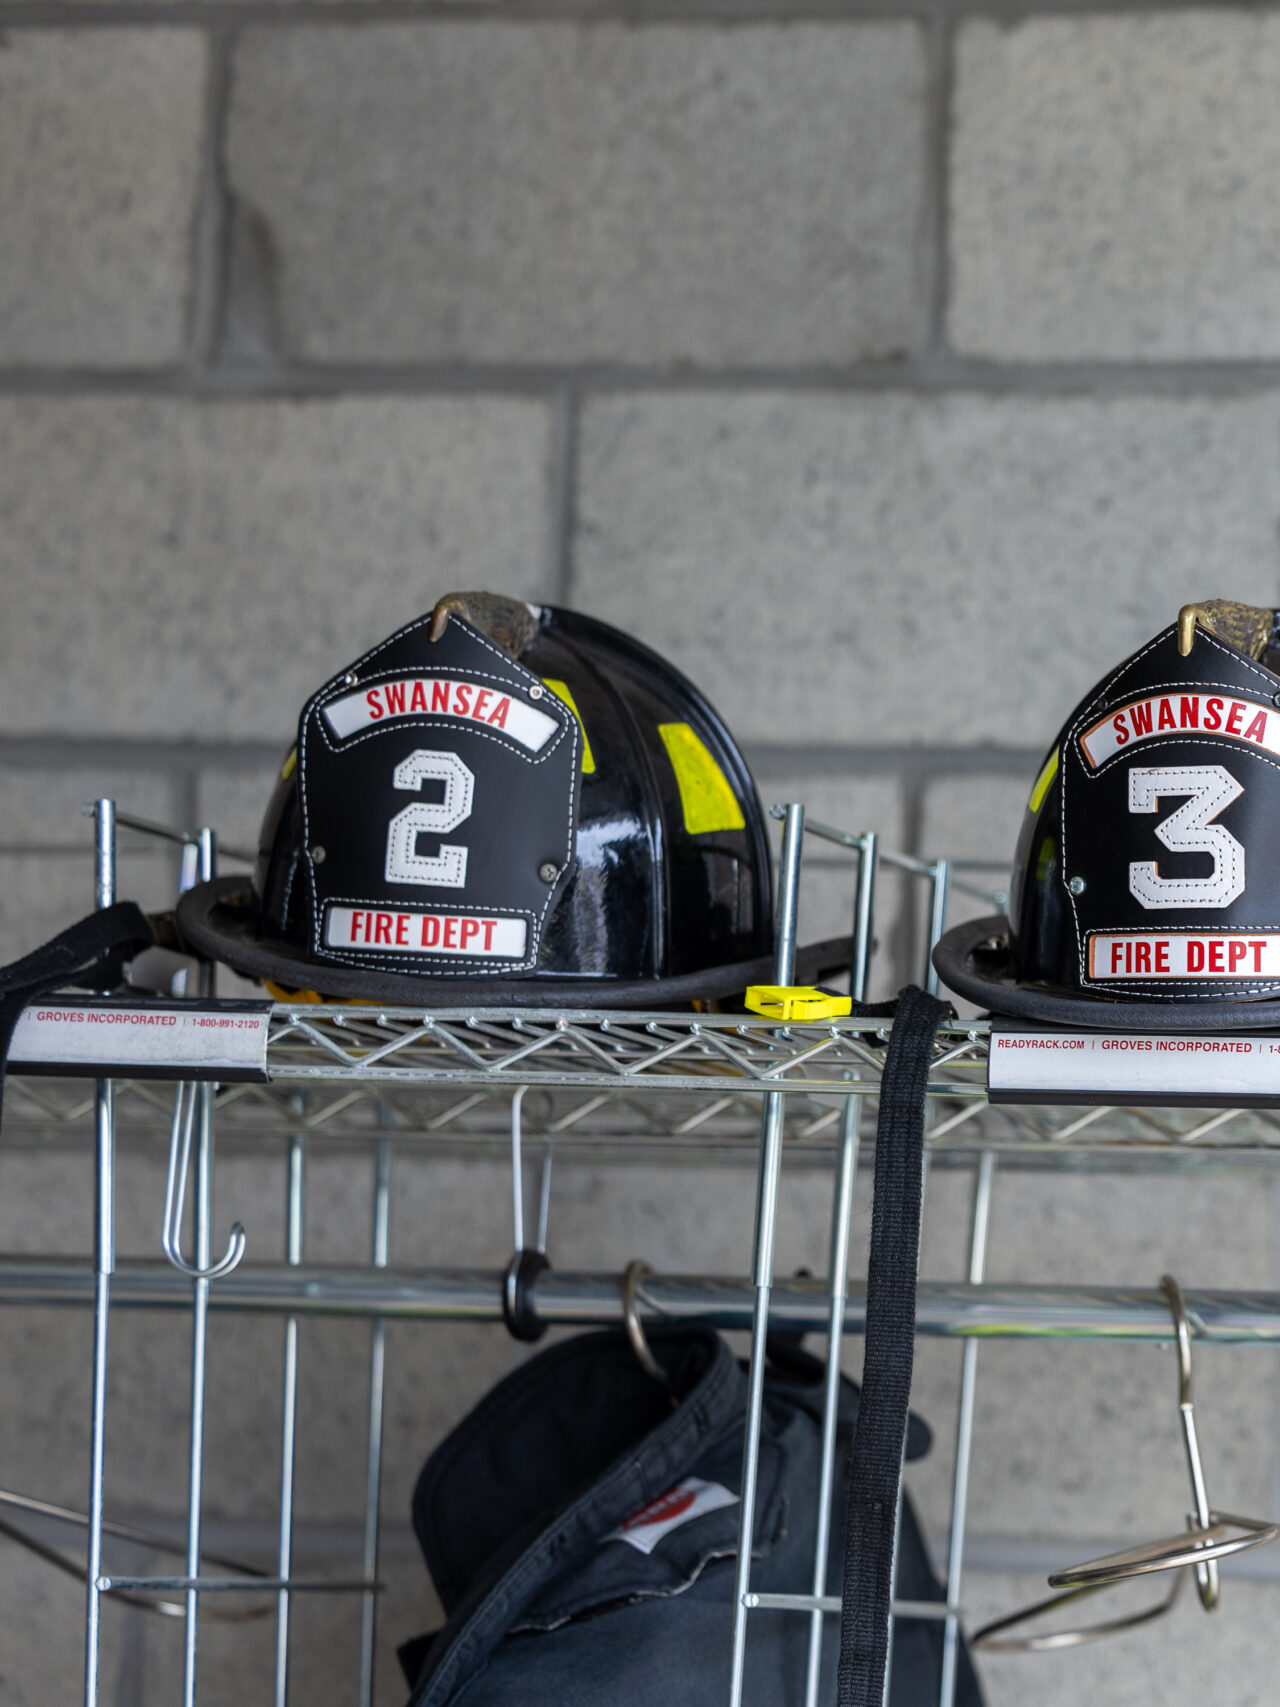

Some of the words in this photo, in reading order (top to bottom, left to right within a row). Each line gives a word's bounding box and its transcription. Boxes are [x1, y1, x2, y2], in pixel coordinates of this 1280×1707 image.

[366, 681, 511, 730] SWANSEA
[1113, 696, 1268, 746] SWANSEA
[385, 749, 475, 888] 2
[1128, 765, 1246, 909] 3
[350, 911, 411, 946] FIRE
[420, 916, 498, 951] DEPT
[1111, 941, 1170, 974] FIRE
[1187, 941, 1267, 973] DEPT
[37, 1011, 84, 1023] GROVES
[87, 1013, 177, 1026] INCORPORATED
[192, 1018, 260, 1029] 1-800-991-2120
[997, 1038, 1085, 1050] READYRACK.COM
[1101, 1039, 1153, 1051] GROVES
[1155, 1040, 1253, 1054] INCORPORATED
